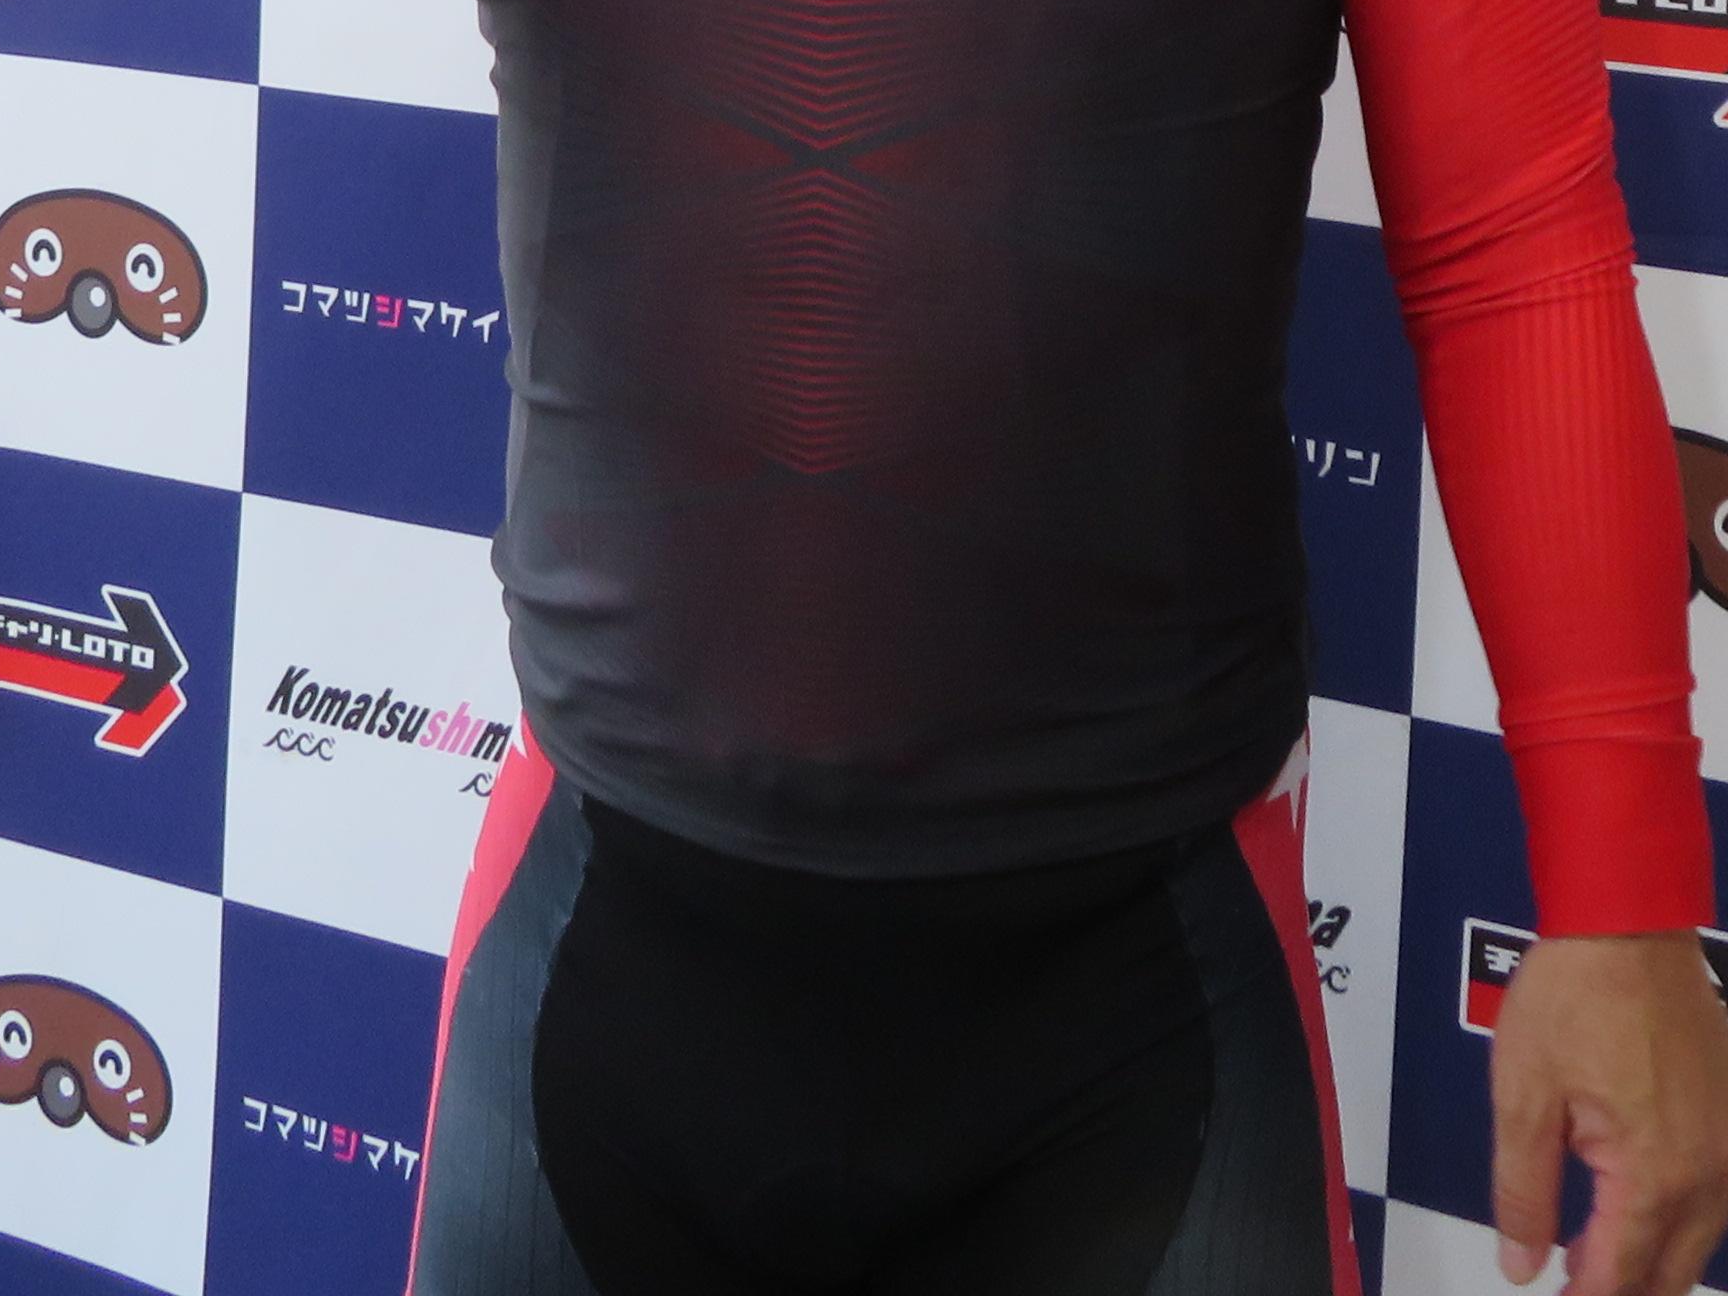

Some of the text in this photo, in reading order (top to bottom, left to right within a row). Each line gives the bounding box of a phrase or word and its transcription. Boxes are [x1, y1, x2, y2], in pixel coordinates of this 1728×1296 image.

[281, 279, 501, 343] コマツシマケイ
[267, 665, 509, 766] Komatsushim
[243, 1096, 421, 1181] コマツシマケ
